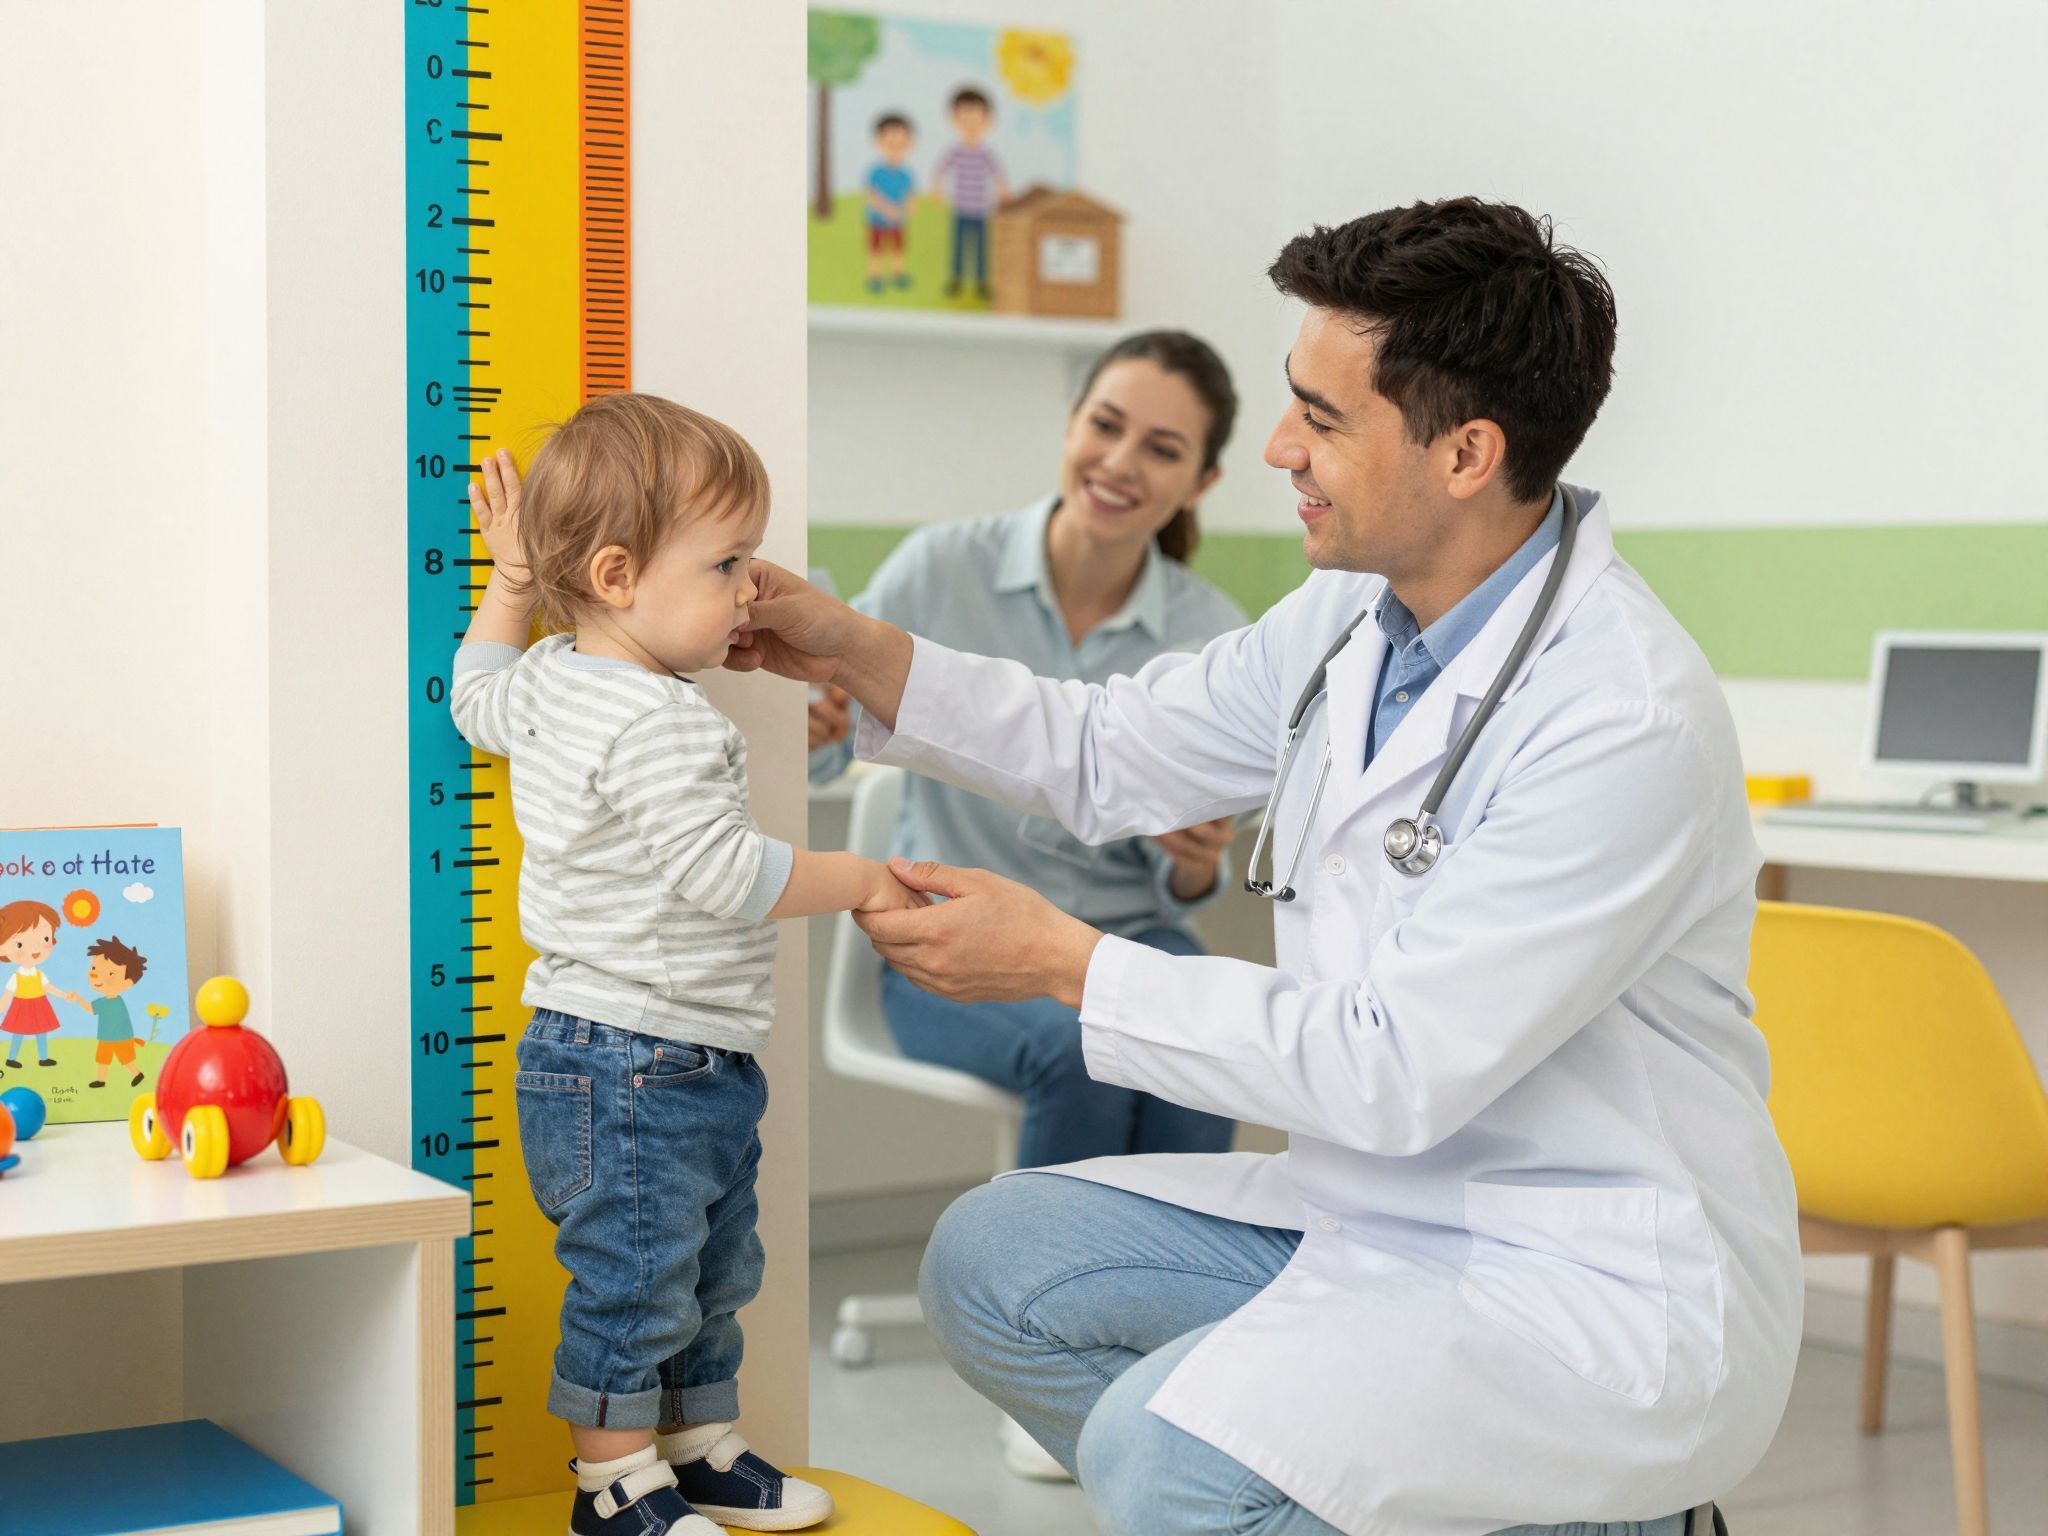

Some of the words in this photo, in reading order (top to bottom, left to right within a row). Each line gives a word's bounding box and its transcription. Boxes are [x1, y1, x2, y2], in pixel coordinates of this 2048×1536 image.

[427, 54, 443, 79] 0
[427, 203, 443, 229] 2
[415, 268, 445, 294] 10
[415, 454, 446, 479] 10
[425, 548, 444, 575] 8
[427, 676, 444, 704] 0
[429, 782, 444, 806] 5
[0, 854, 35, 877] ok
[430, 850, 442, 874] 1
[430, 963, 446, 988] 5
[419, 1030, 450, 1056] 10
[419, 1131, 451, 1159] 10
